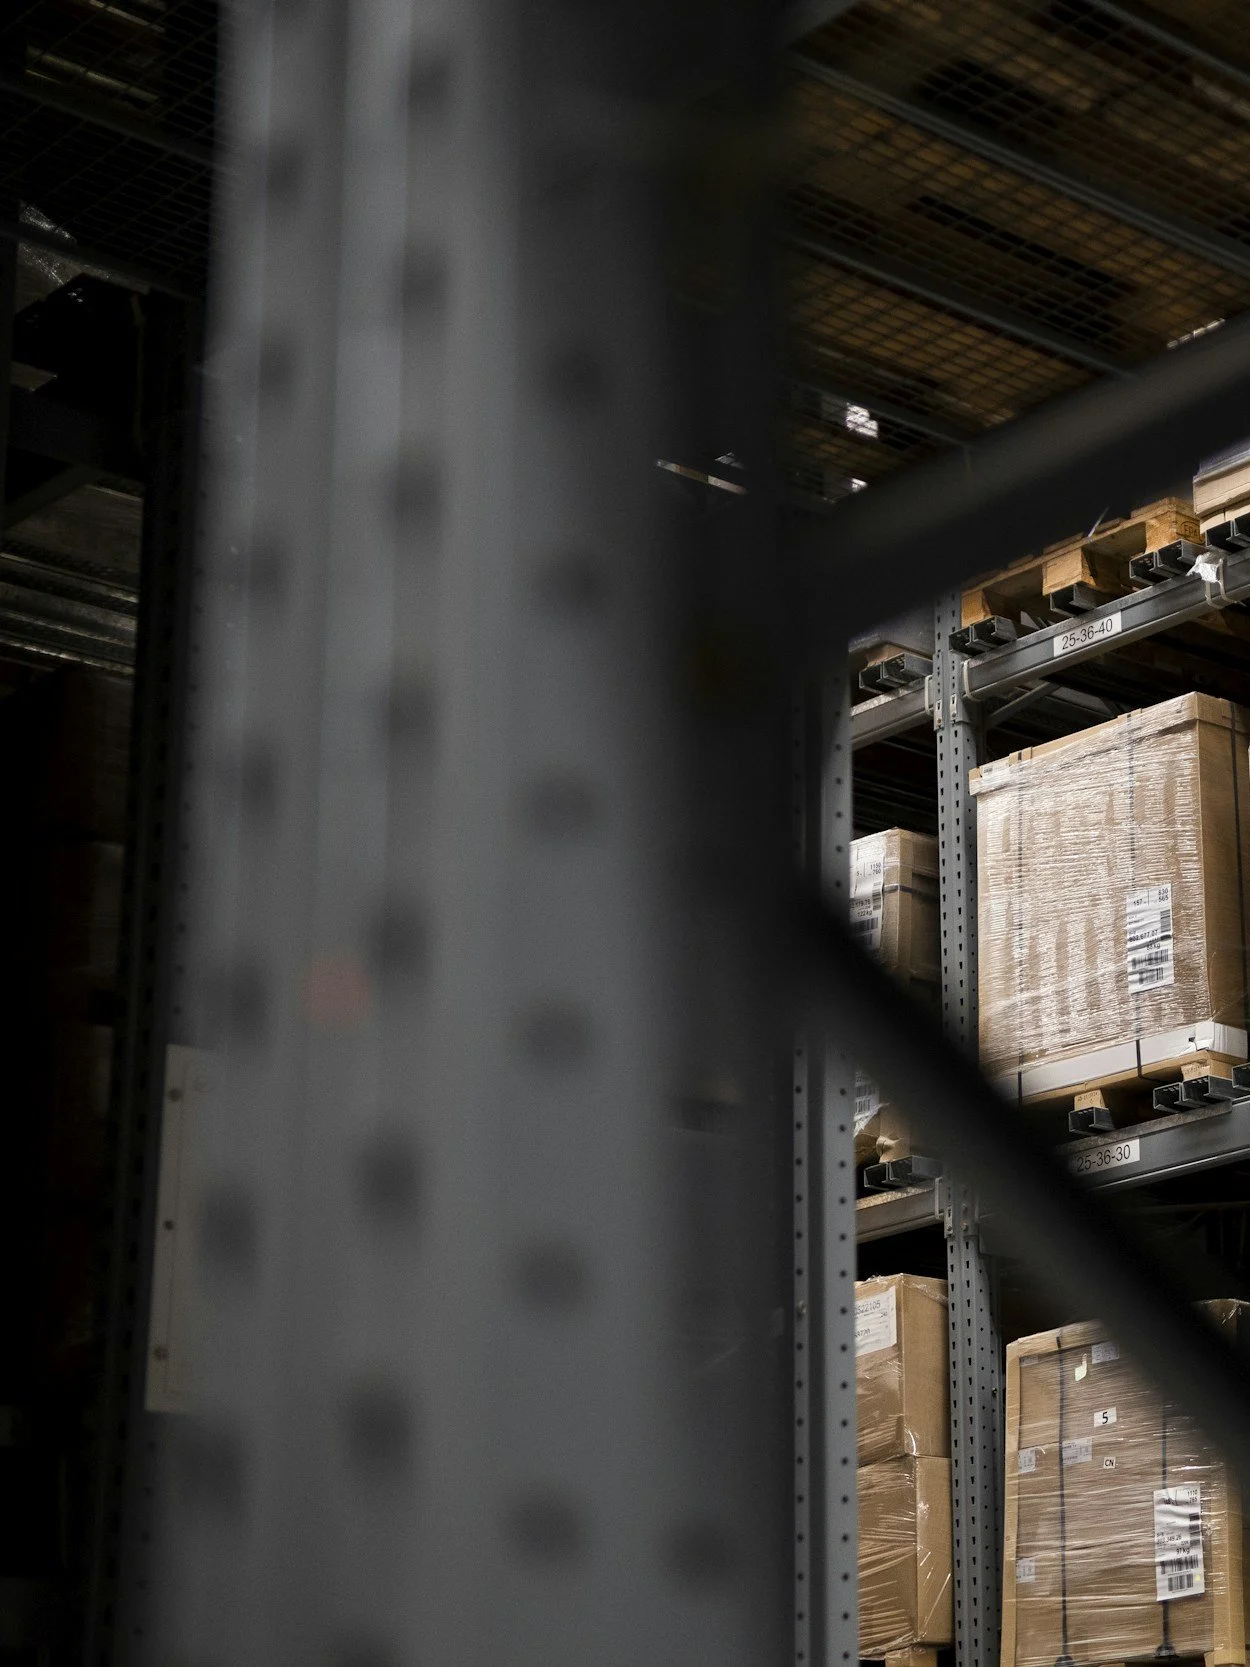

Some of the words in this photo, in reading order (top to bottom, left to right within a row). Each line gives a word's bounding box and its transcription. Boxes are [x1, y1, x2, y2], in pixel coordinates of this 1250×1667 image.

[1061, 618, 1113, 650] 25-36-40
[1076, 1144, 1131, 1173] 25-36-30
[1101, 1411, 1109, 1425] 5
[1104, 1458, 1114, 1468] CN
